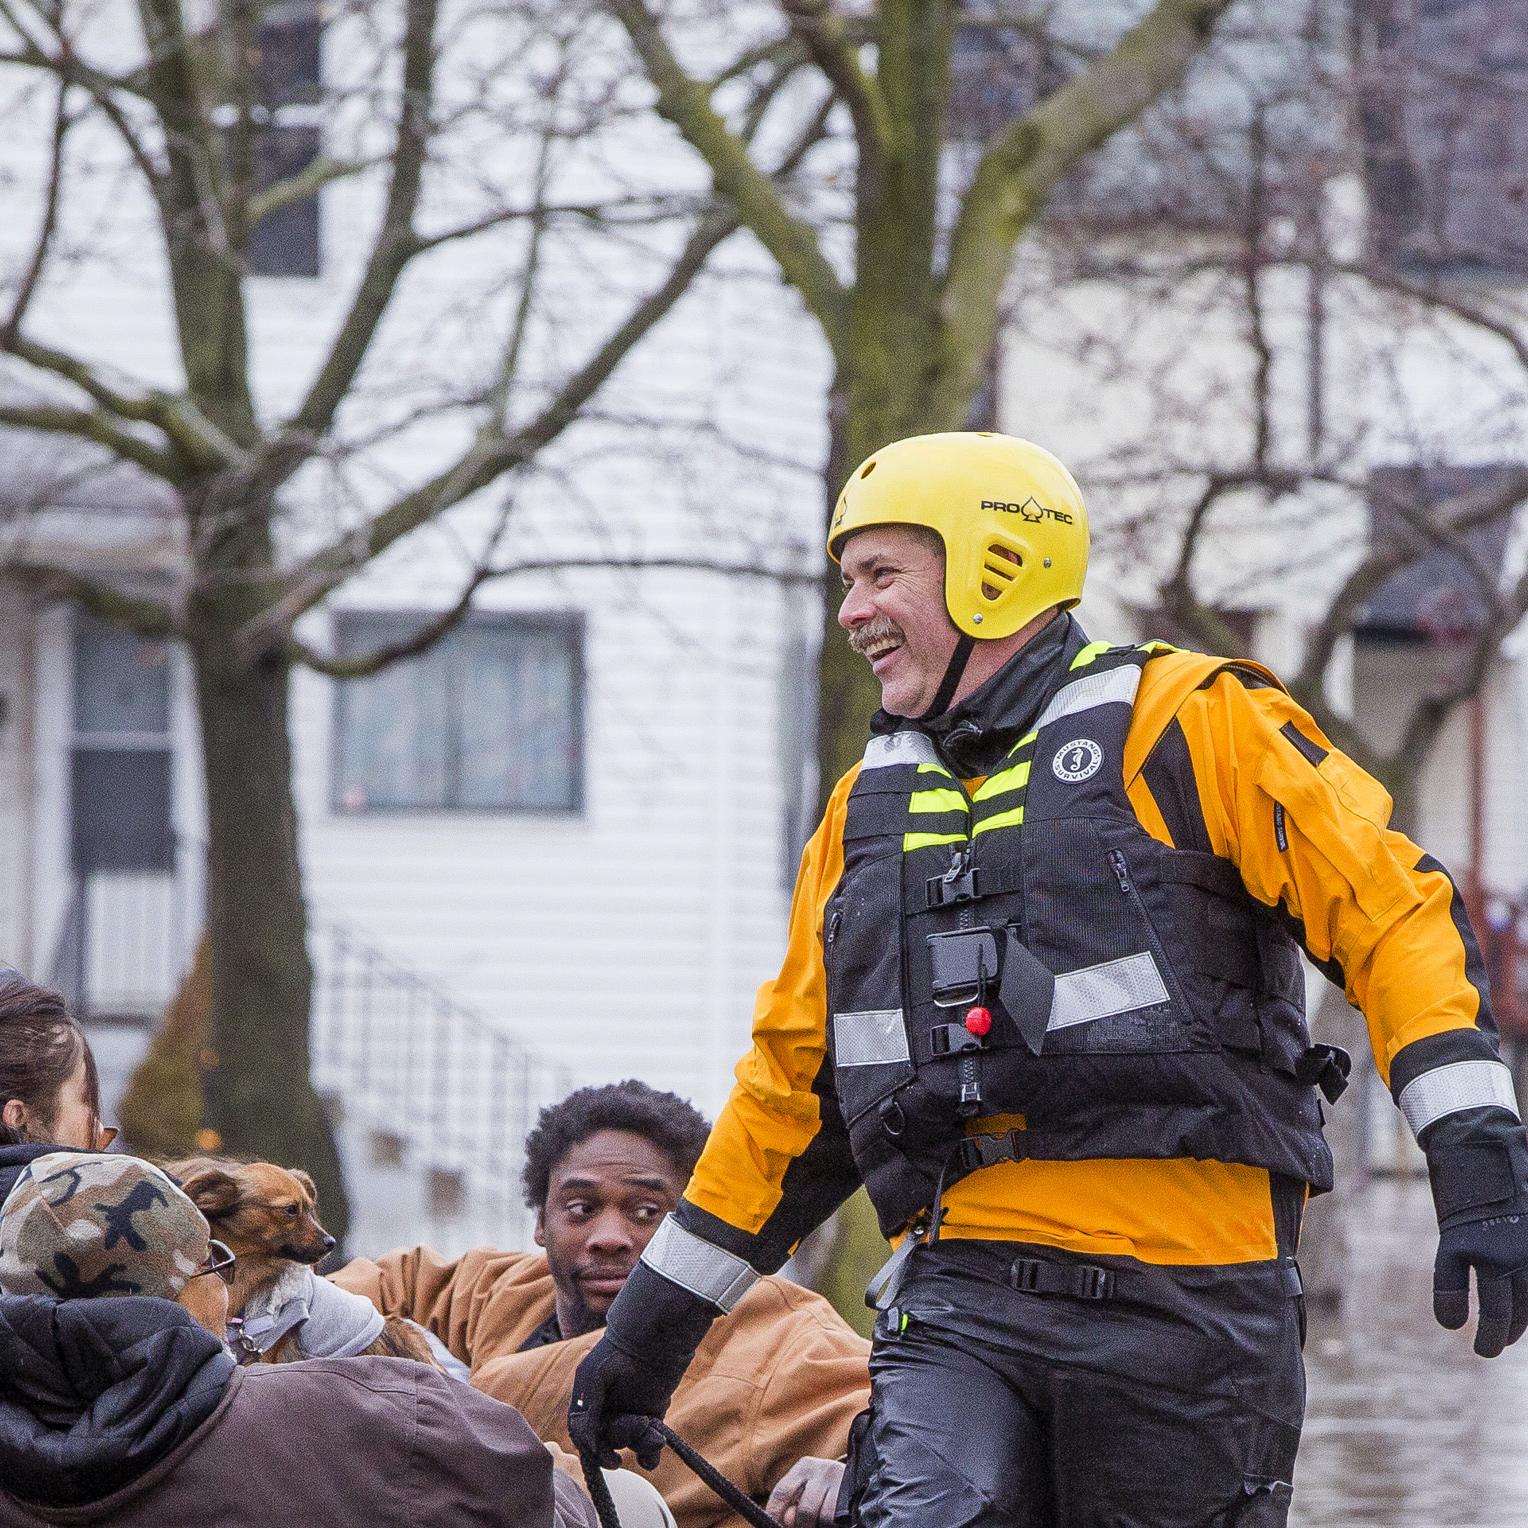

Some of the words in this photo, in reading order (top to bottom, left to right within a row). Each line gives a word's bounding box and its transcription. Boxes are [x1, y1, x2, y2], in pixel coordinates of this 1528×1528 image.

[981, 500, 1020, 513] PRO
[1043, 508, 1073, 524] TEC
[1056, 741, 1099, 760] MUSTANG
[1055, 760, 1099, 779] SURVIVAL
